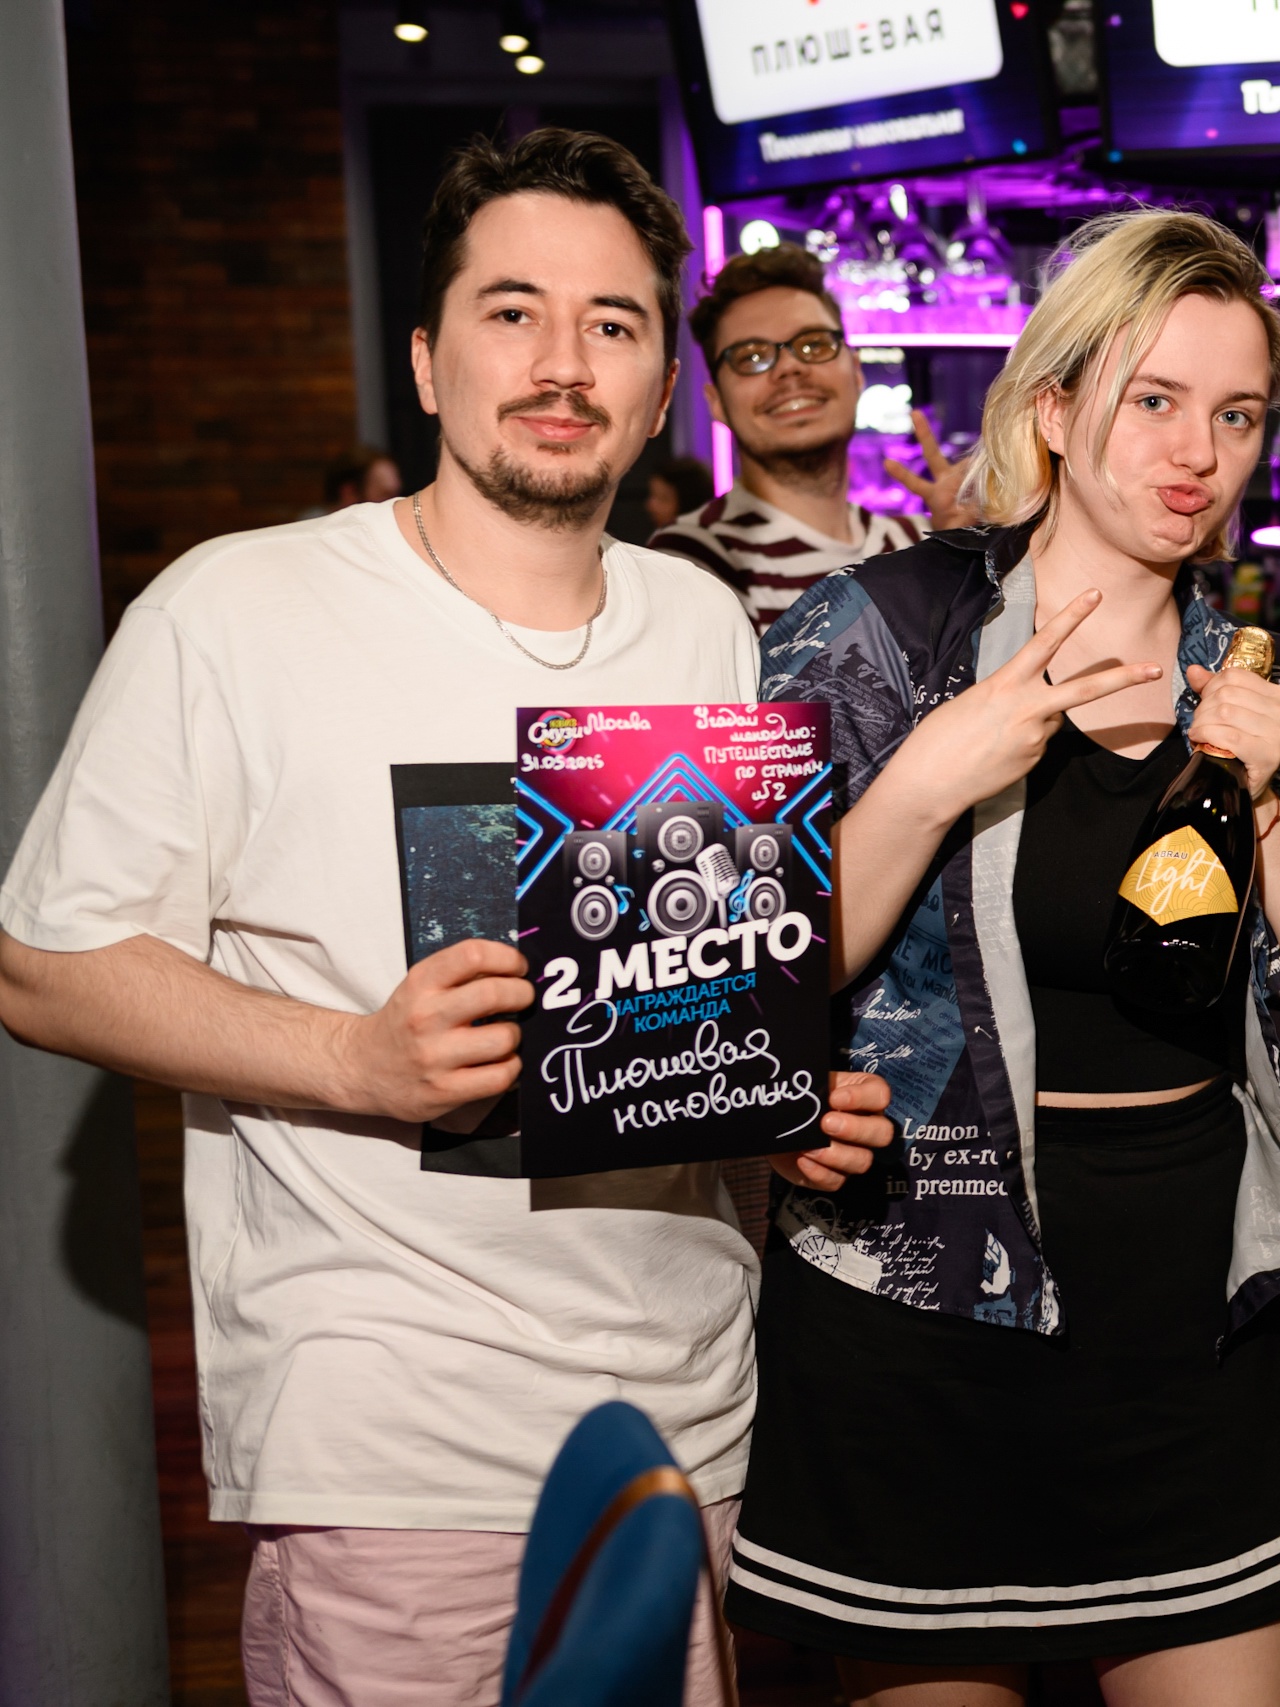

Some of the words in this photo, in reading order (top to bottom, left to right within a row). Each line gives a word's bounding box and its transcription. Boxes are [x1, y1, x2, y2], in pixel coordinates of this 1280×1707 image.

[583, 711, 652, 735] Москва
[693, 703, 759, 729] Угадай
[527, 721, 584, 744] Смузи
[703, 742, 814, 764] ПУТЕШЕСТВИЕ
[1152, 850, 1189, 860] ABRAU
[1135, 848, 1226, 916] Light
[542, 956, 582, 1010] 2
[595, 911, 813, 1000] МЕСТО
[606, 971, 757, 1018] НАГРАЖДАЕТСЯ
[634, 998, 732, 1033] КОМАНДА
[541, 999, 781, 1114] Плюшевая
[613, 1070, 822, 1139] наковальня
[902, 1118, 980, 1142] Lennon
[909, 1147, 938, 1172] by
